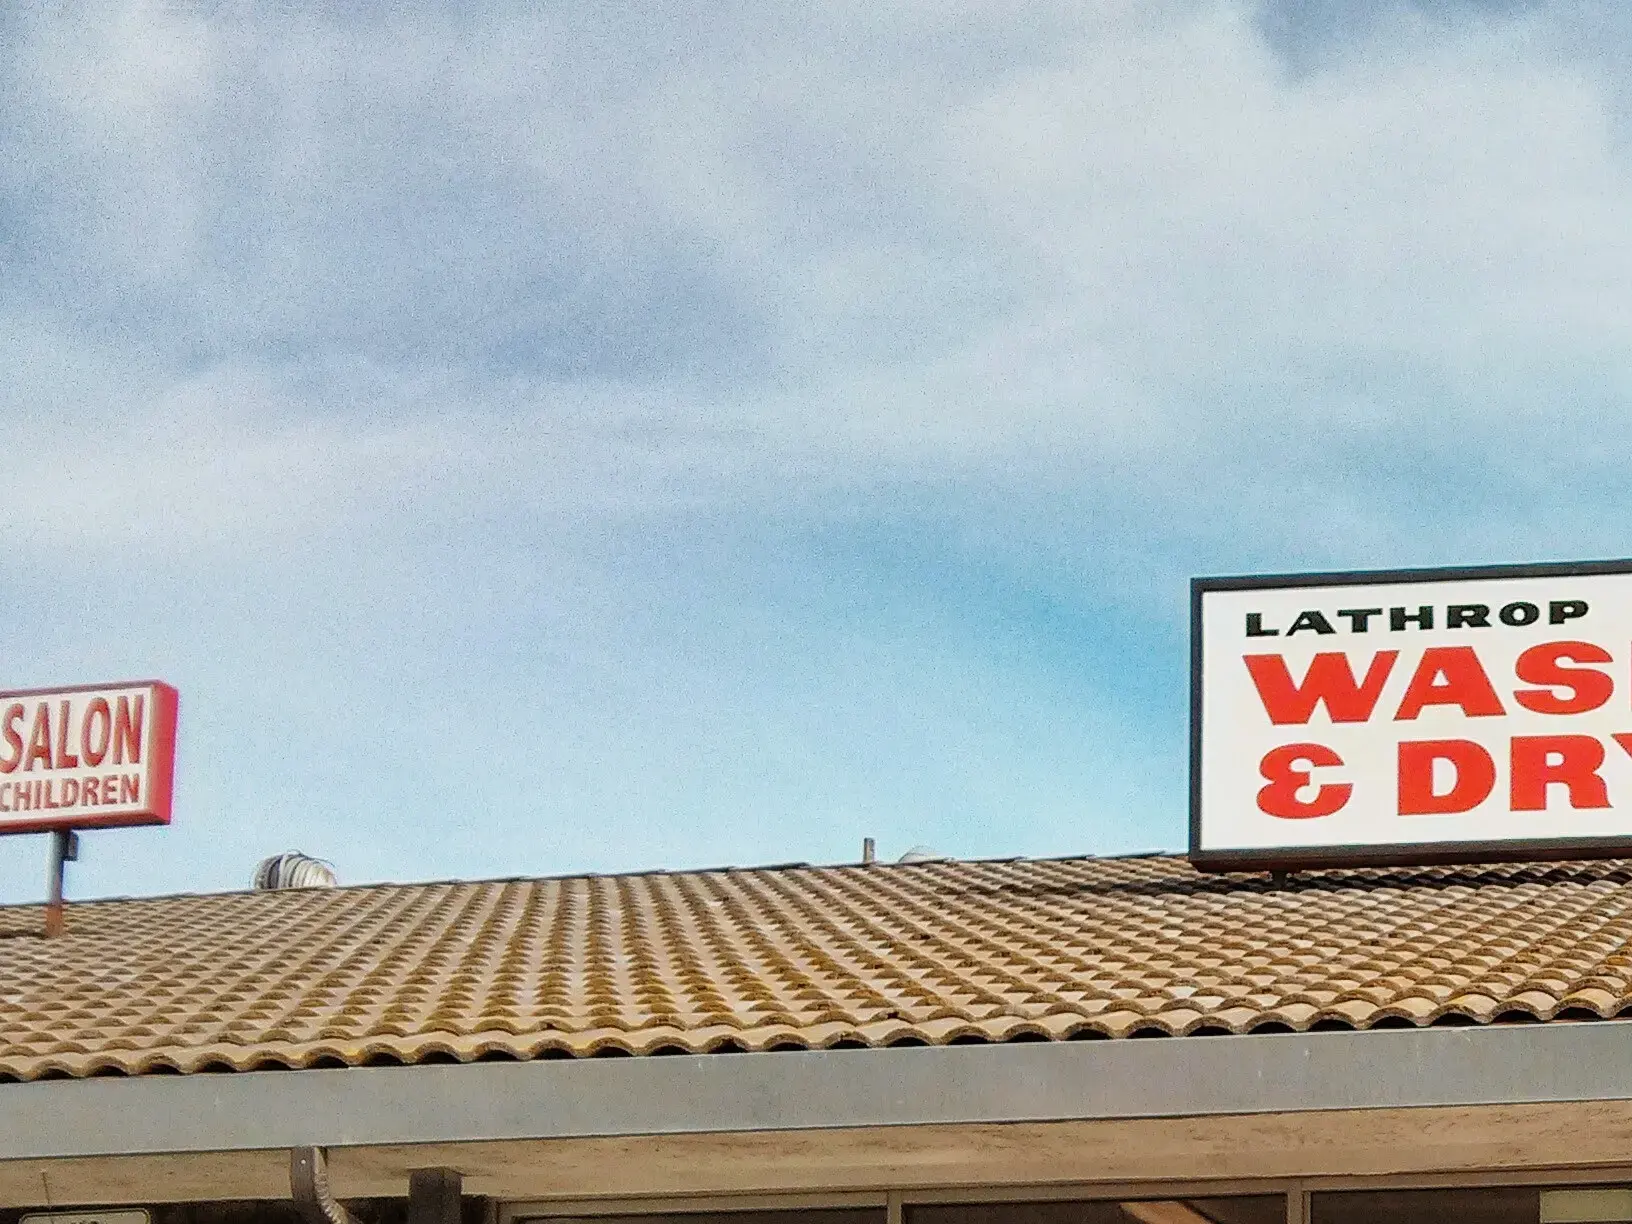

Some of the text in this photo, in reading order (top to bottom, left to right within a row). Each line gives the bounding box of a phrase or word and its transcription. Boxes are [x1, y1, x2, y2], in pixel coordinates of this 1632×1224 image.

[1245, 600, 1590, 637] LATHROP
[0, 694, 144, 774] SALON
[0, 773, 140, 812] CHILDREN
[1256, 743, 1354, 819] &
